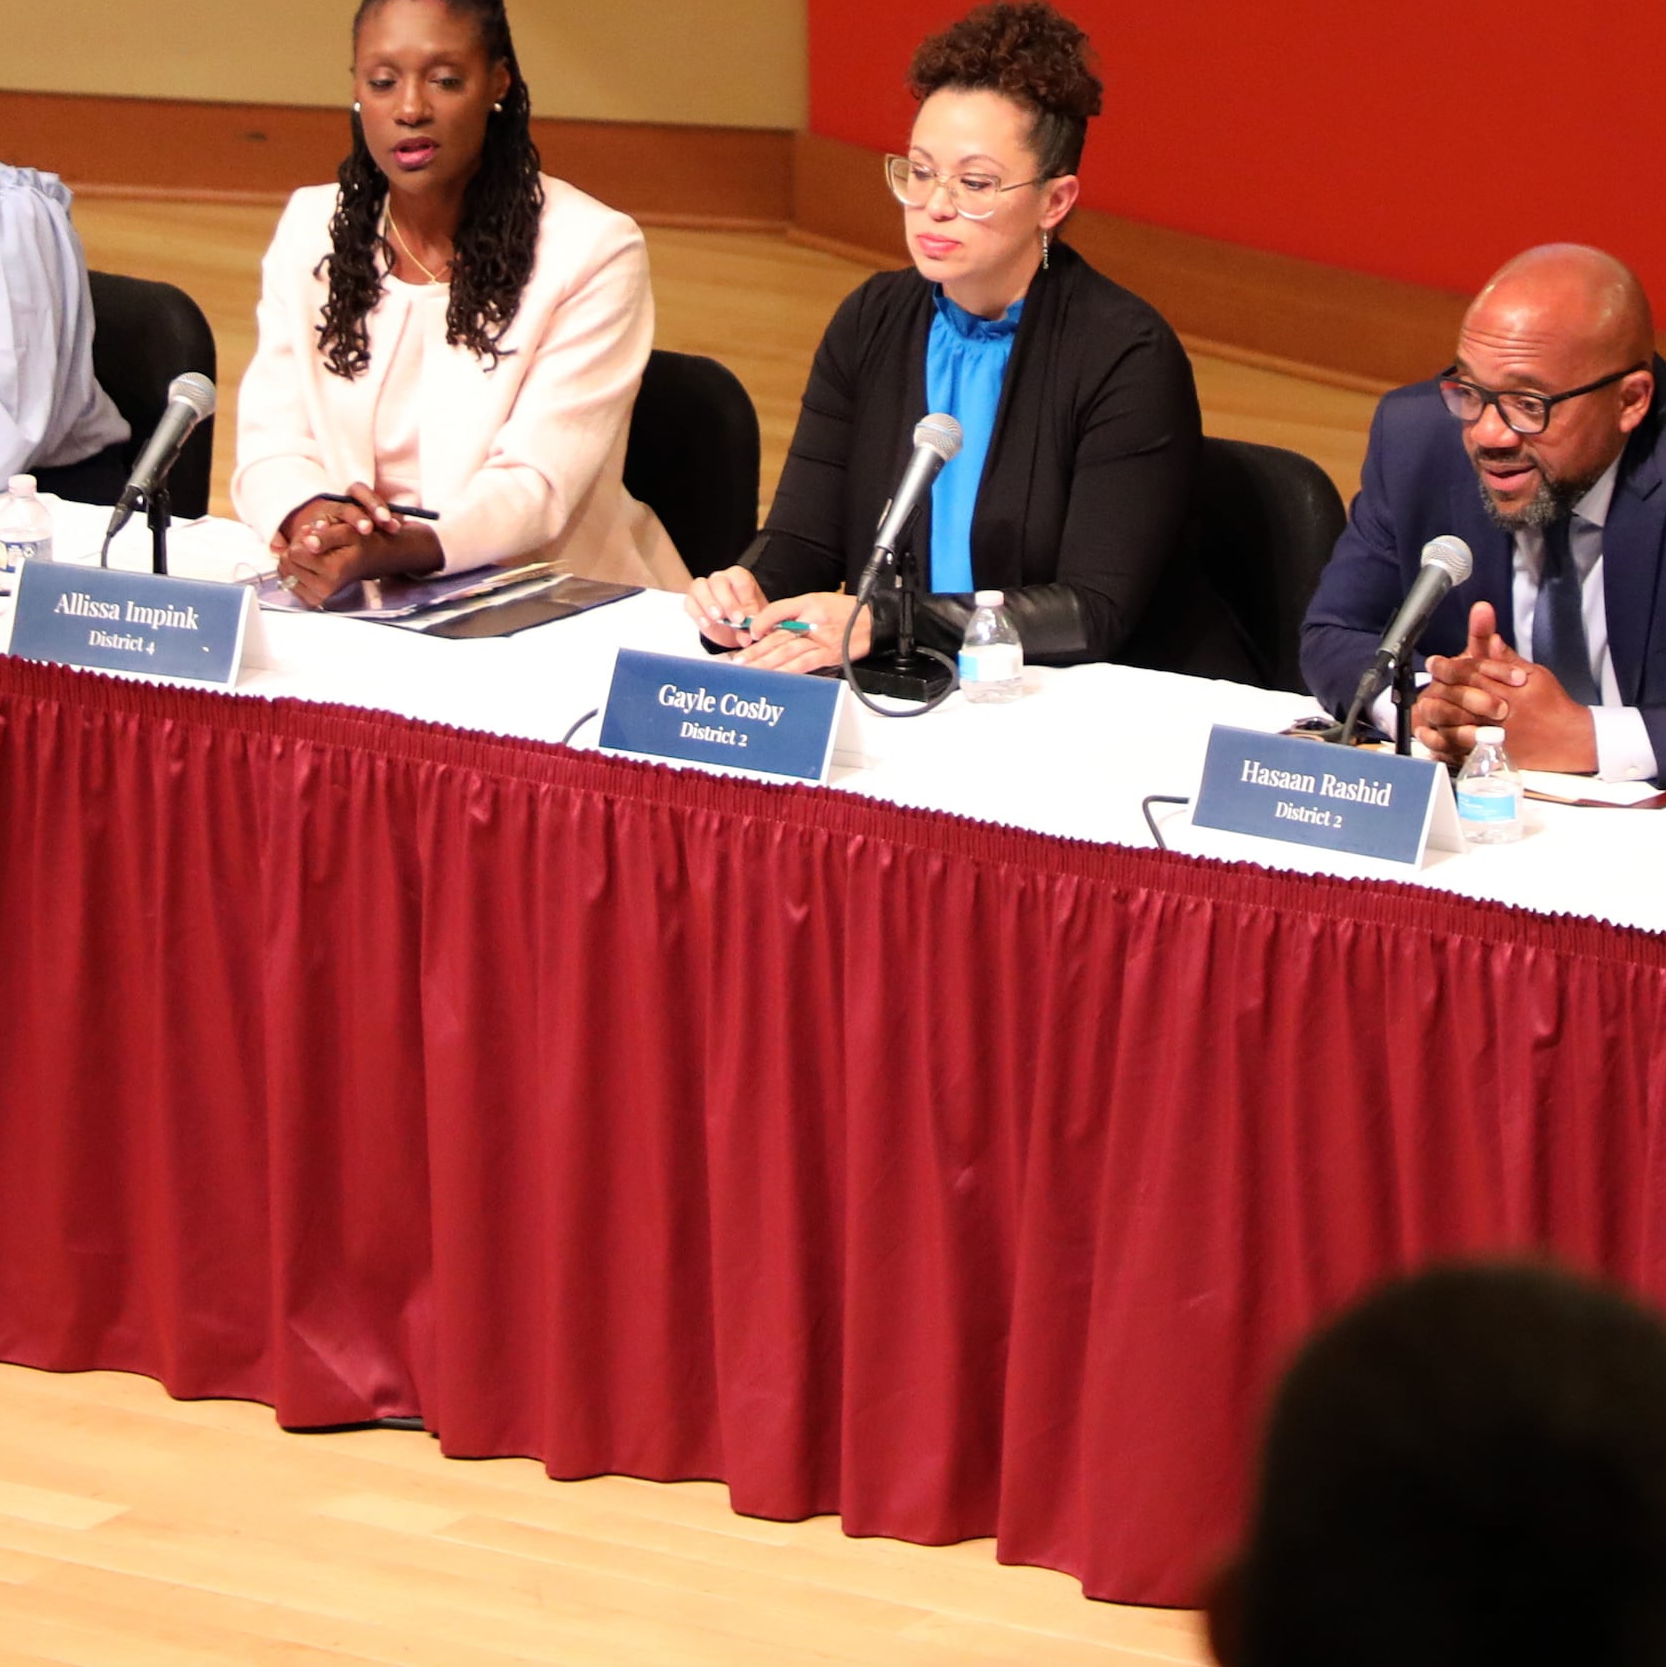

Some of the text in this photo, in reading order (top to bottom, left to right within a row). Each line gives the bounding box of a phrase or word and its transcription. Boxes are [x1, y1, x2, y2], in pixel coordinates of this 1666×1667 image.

[54, 591, 199, 631] Allissa Impink
[88, 630, 156, 656] District 4
[658, 684, 784, 727] Gayle Cosby
[679, 721, 748, 747] District 2
[1240, 760, 1393, 807] Hasaan Rashid
[1275, 801, 1343, 829] District 2
